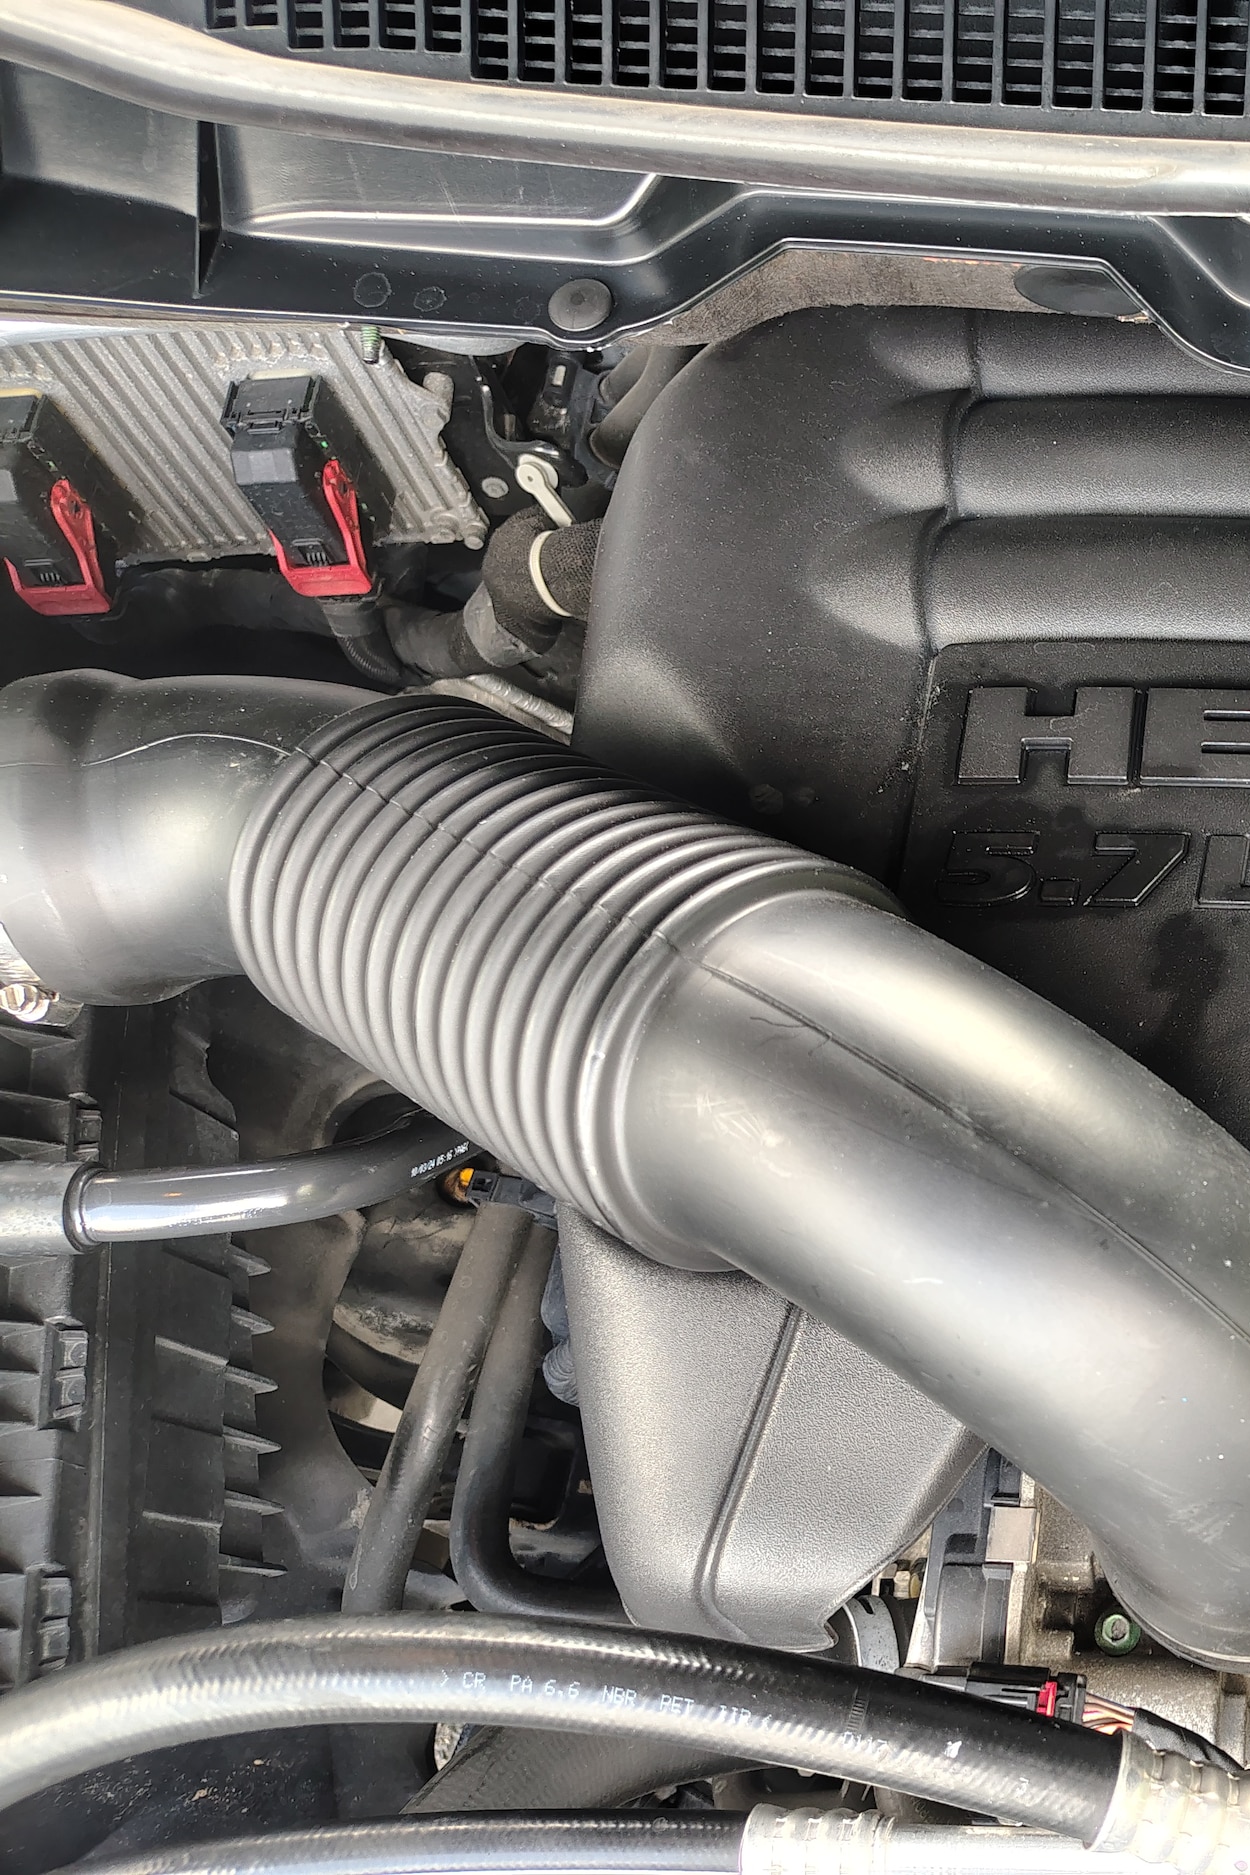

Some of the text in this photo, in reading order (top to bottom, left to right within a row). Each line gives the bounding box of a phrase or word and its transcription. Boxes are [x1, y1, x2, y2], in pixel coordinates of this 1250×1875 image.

[463, 1671, 486, 1692] CR
[510, 1674, 533, 1693] PA
[544, 1679, 581, 1698] 6.6
[602, 1685, 637, 1706] NBR
